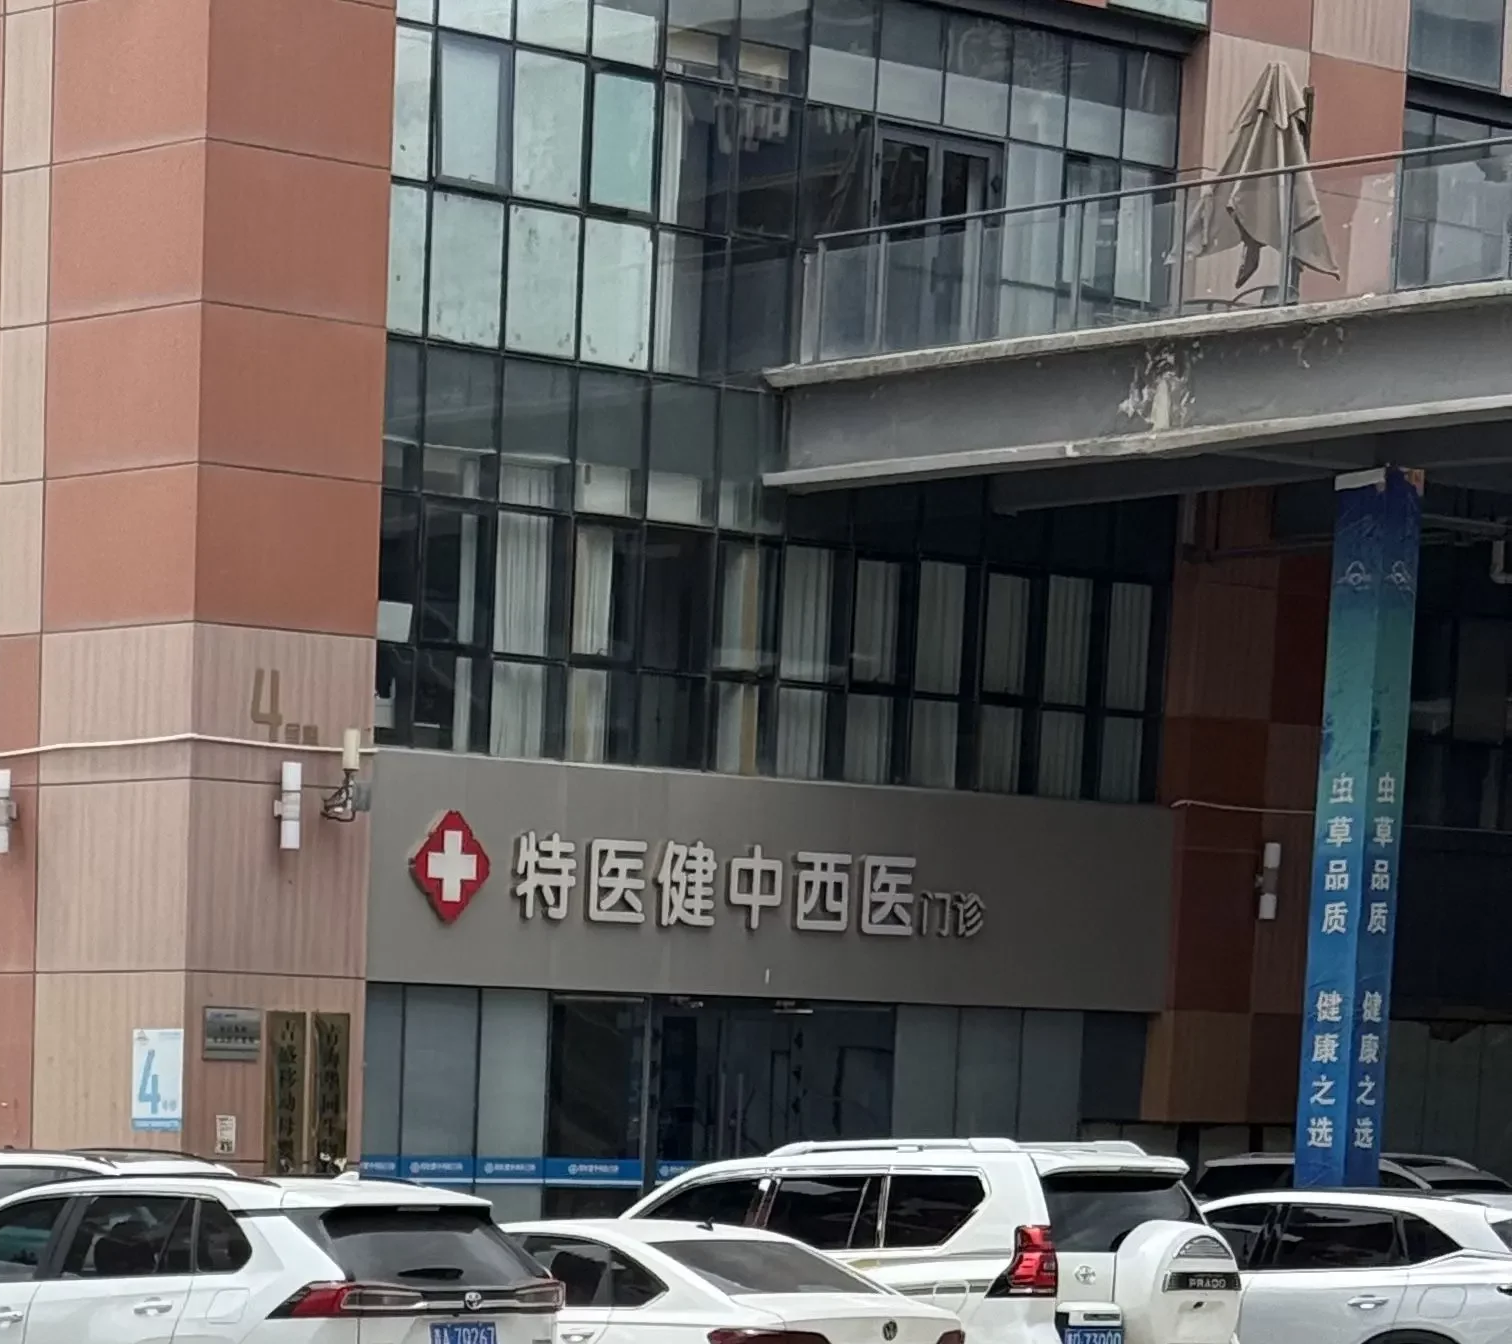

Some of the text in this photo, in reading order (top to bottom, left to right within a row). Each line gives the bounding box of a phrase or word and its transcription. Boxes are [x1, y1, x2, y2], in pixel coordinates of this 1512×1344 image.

[517, 831, 986, 937] 特医健中西医门诊
[1307, 772, 1354, 1148] 虫草品质 健康之选
[1354, 772, 1396, 1148] 虫草品质 健康之选
[1189, 1278, 1226, 1288] PRADO
